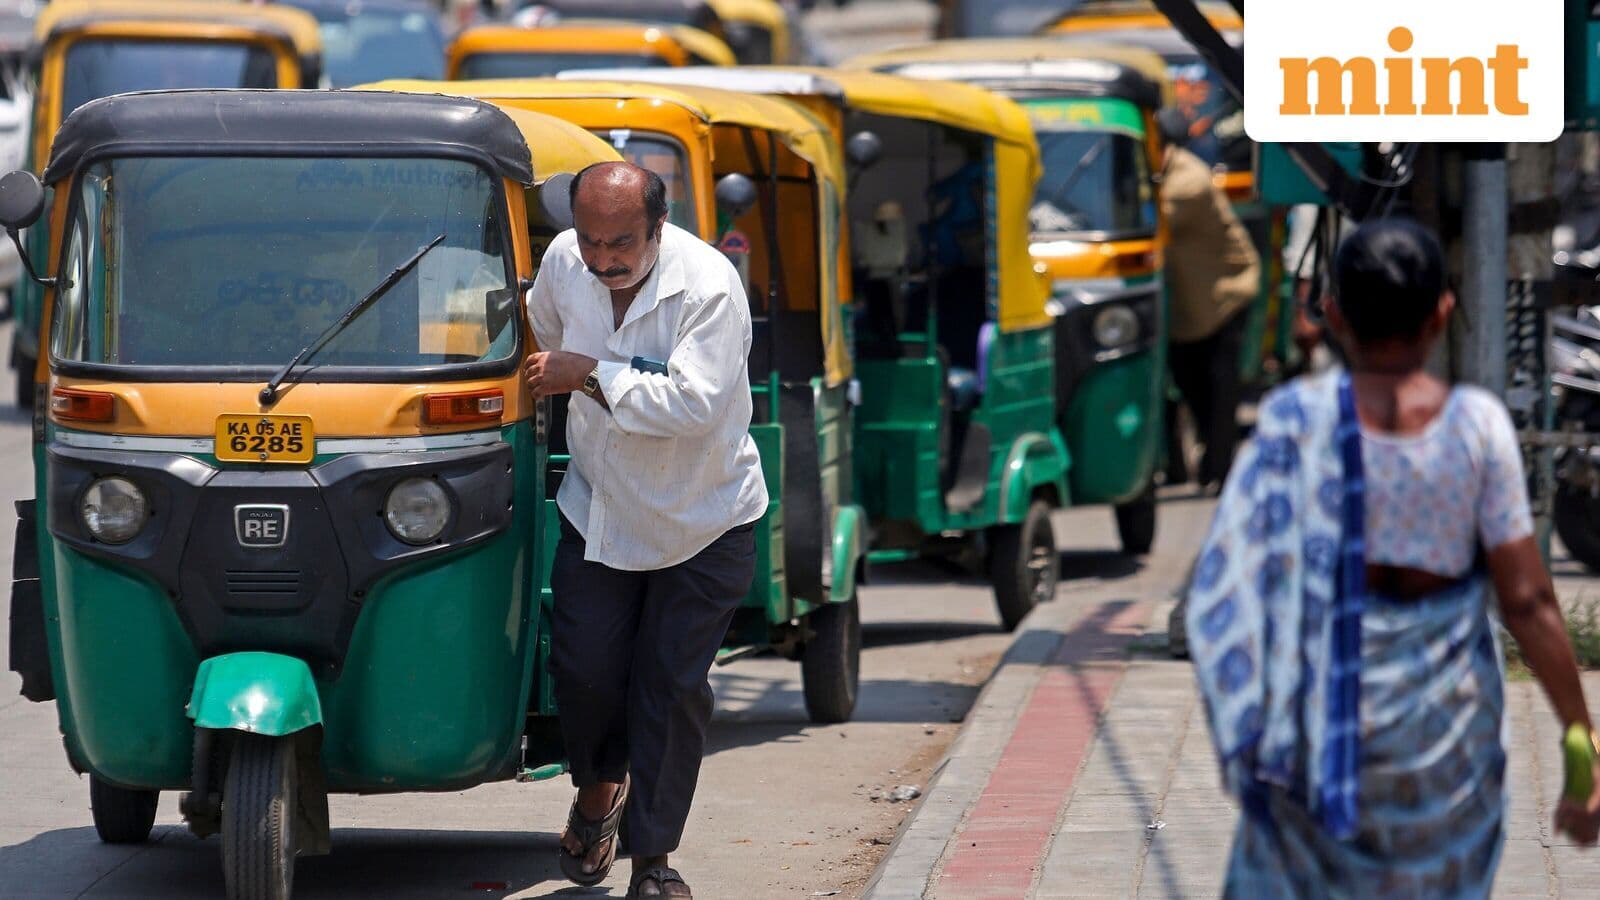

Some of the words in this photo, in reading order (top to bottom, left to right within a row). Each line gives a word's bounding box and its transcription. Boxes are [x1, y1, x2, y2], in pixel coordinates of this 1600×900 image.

[228, 422, 250, 435] KA
[256, 422, 275, 436] 05
[281, 423, 302, 436] AE
[230, 436, 304, 453] 6285
[245, 519, 278, 538] RE
